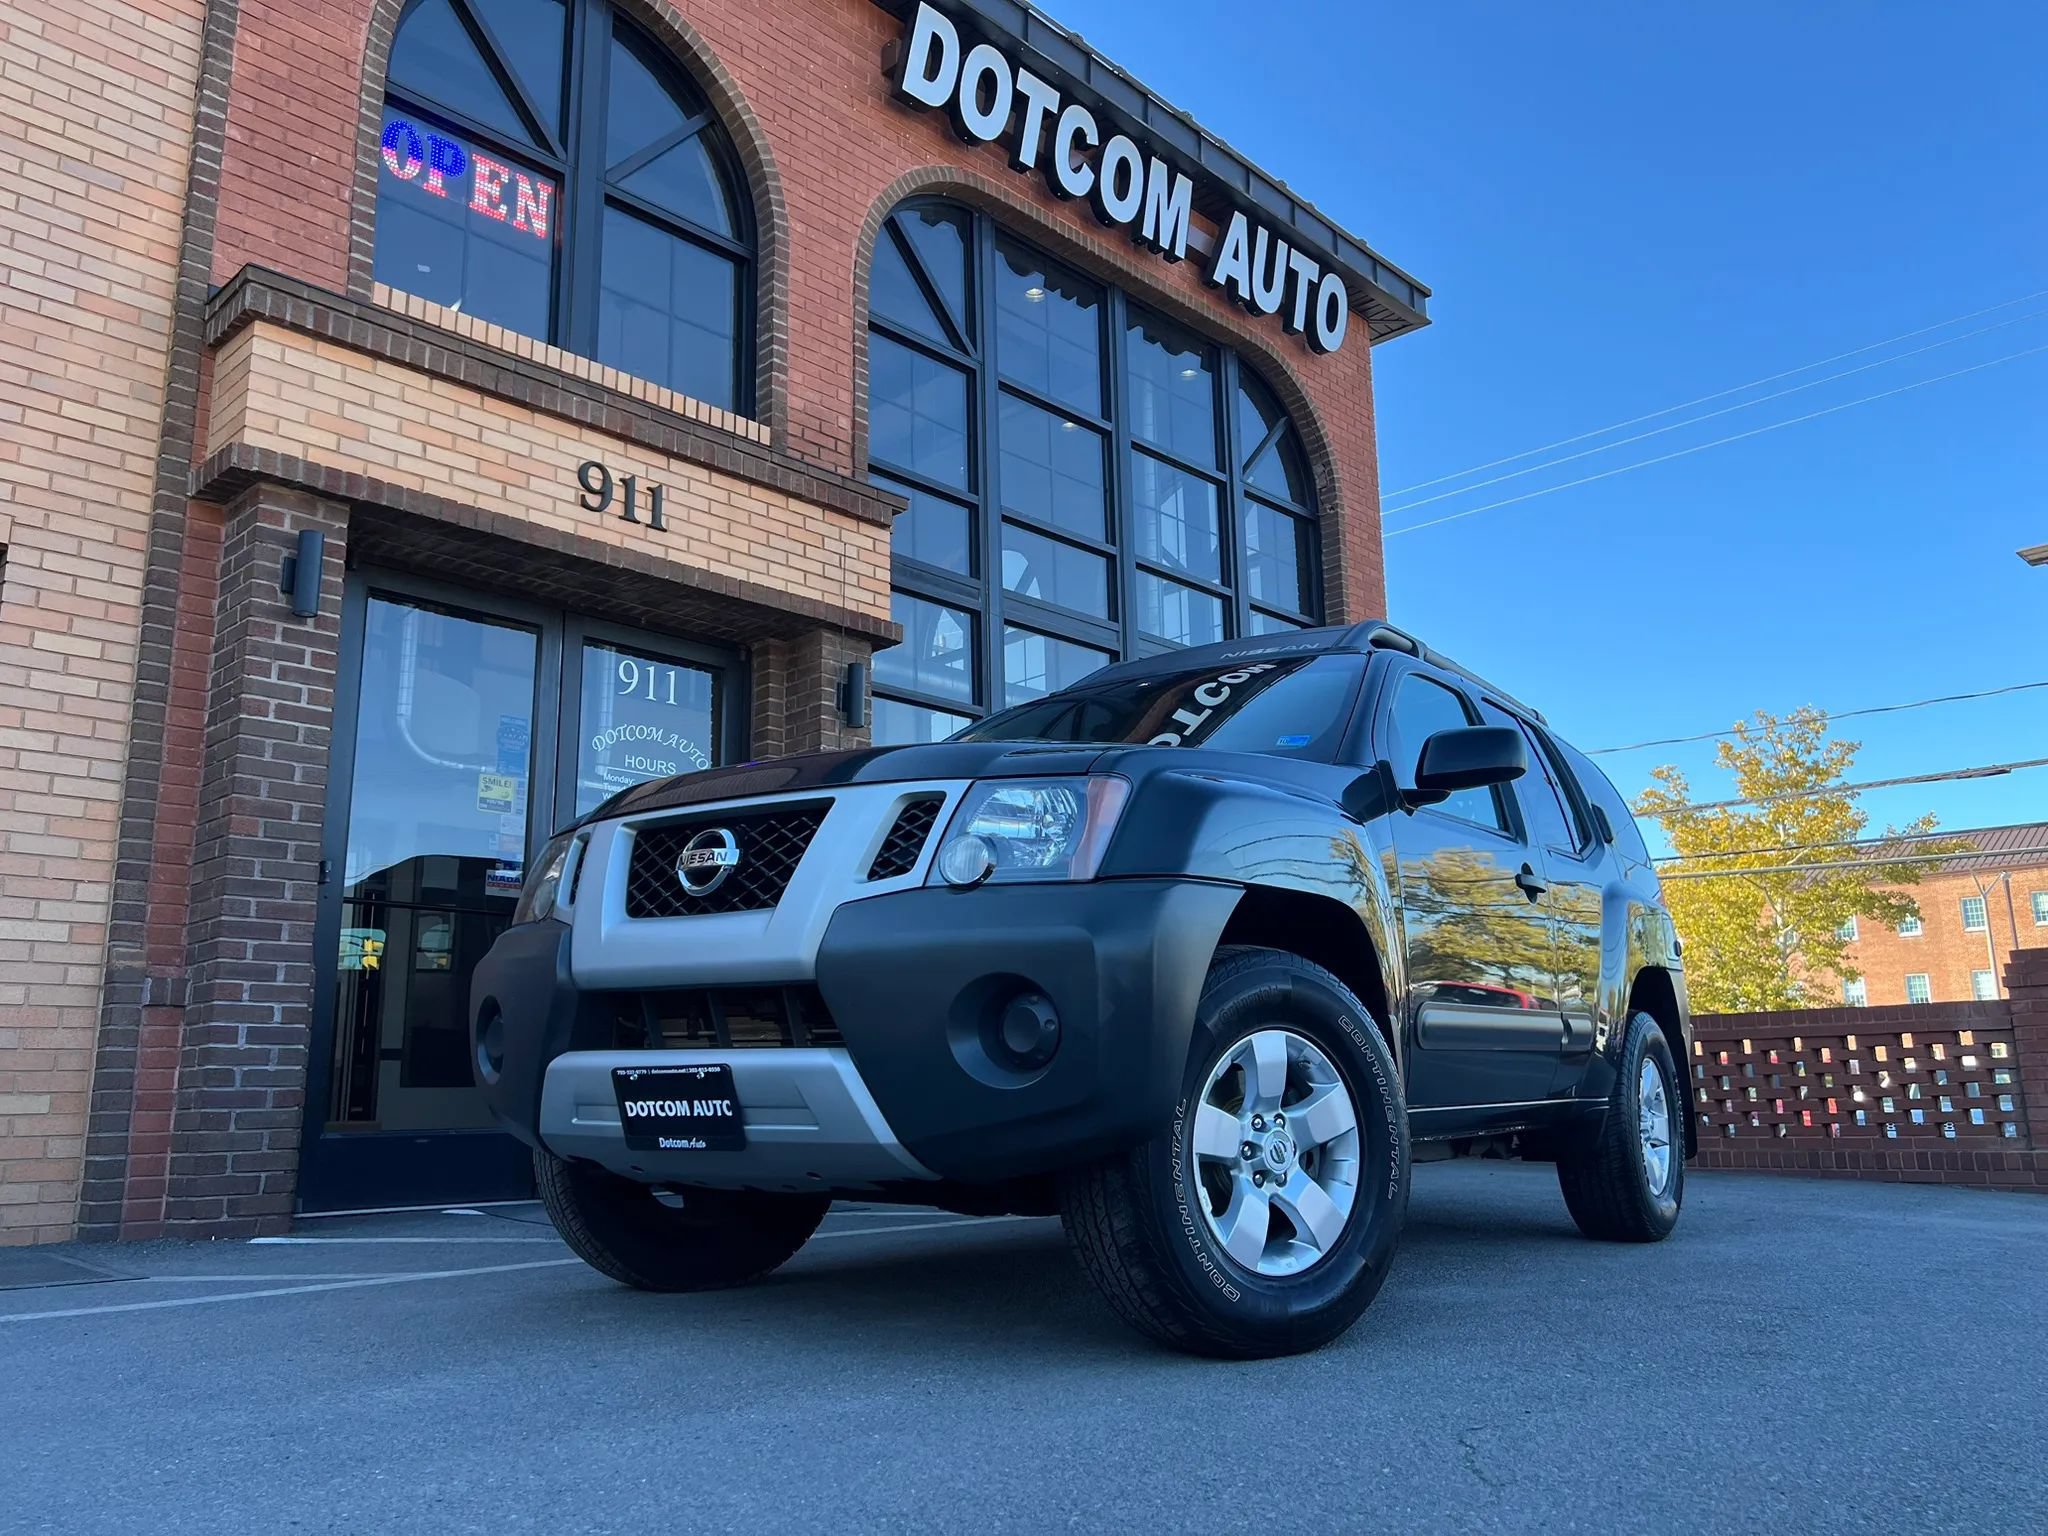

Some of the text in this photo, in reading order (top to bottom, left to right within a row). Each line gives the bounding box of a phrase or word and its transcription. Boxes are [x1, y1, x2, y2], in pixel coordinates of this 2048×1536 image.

[382, 119, 554, 239] OPEN
[901, 1, 1348, 353] DOTCOM AUTO
[577, 460, 668, 533] 911
[1220, 642, 1320, 660] NISSAN
[617, 659, 678, 706] 911
[591, 723, 710, 770] DOTCOM AUTO
[624, 754, 677, 775] HOURS
[481, 776, 512, 788] SMILE!
[487, 874, 521, 884] NIADA
[680, 851, 728, 866] NISSAN
[624, 1100, 691, 1117] DOTCOM
[1338, 1015, 1400, 1200] CONTINENTAL
[1172, 1098, 1241, 1302] CONTINENTAL
